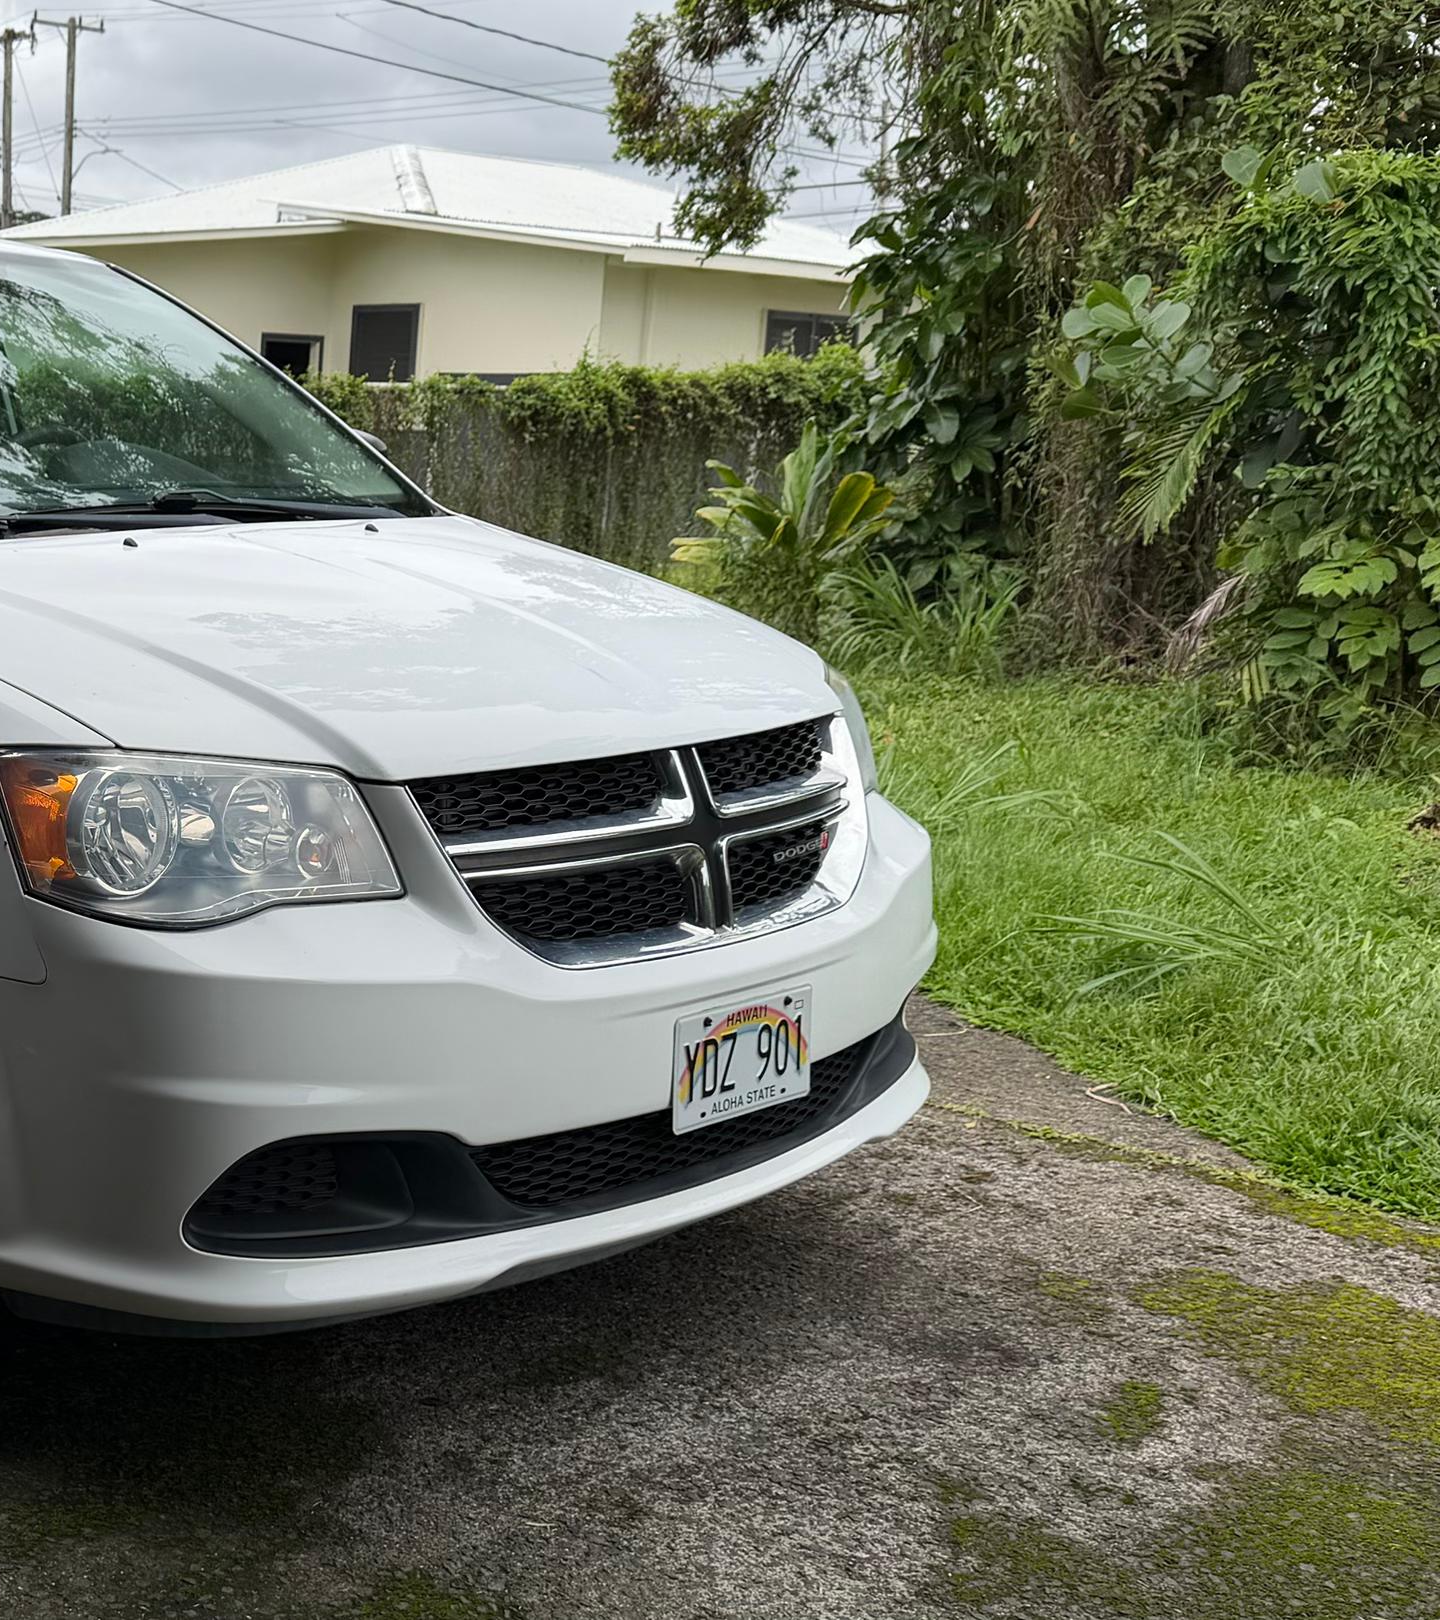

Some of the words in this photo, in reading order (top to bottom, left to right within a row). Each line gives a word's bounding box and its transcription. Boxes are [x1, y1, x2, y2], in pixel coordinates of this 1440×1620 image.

[773, 839, 822, 862] DODGE
[683, 1033, 738, 1117] YDZ
[756, 1013, 802, 1082] 901
[711, 1095, 744, 1115] ALOHA
[746, 1085, 776, 1104] STATE
